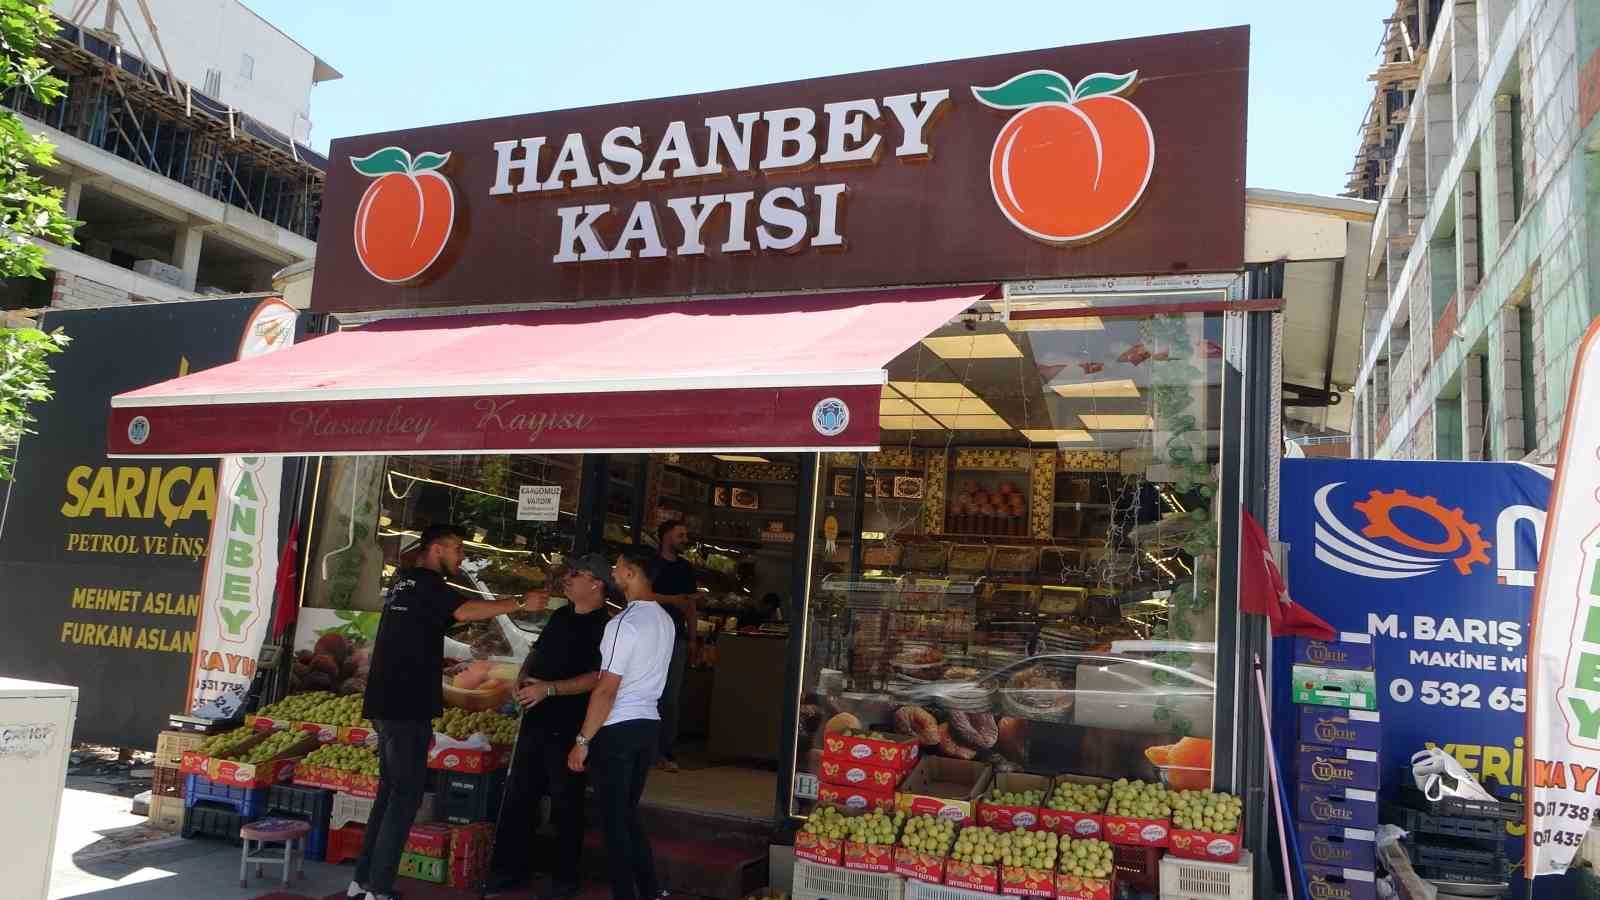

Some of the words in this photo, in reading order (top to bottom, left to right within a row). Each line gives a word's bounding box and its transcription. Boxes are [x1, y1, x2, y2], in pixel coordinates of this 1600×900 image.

[489, 89, 950, 196] HASANBEY
[553, 183, 847, 264] KAYISI
[290, 404, 435, 442] Hasanbey
[61, 465, 217, 528] SARIÇA
[66, 533, 140, 554] PETROL
[143, 535, 168, 556] VE
[170, 533, 210, 561] İNŞ
[72, 587, 142, 612] MEHMET
[142, 592, 200, 617] ASLAN
[60, 622, 132, 648] FURKAN
[135, 627, 197, 653] ASLAN
[1368, 613, 1407, 639] M.
[1413, 616, 1522, 651] BARIŞ
[1410, 650, 1497, 671] MAKİNE
[1389, 678, 1414, 703] 0
[1420, 680, 1481, 709] 532
[1488, 686, 1527, 713] 65
[1534, 759, 1600, 796] KAY
[1559, 802, 1590, 821] 738
[1553, 830, 1583, 847] 435
